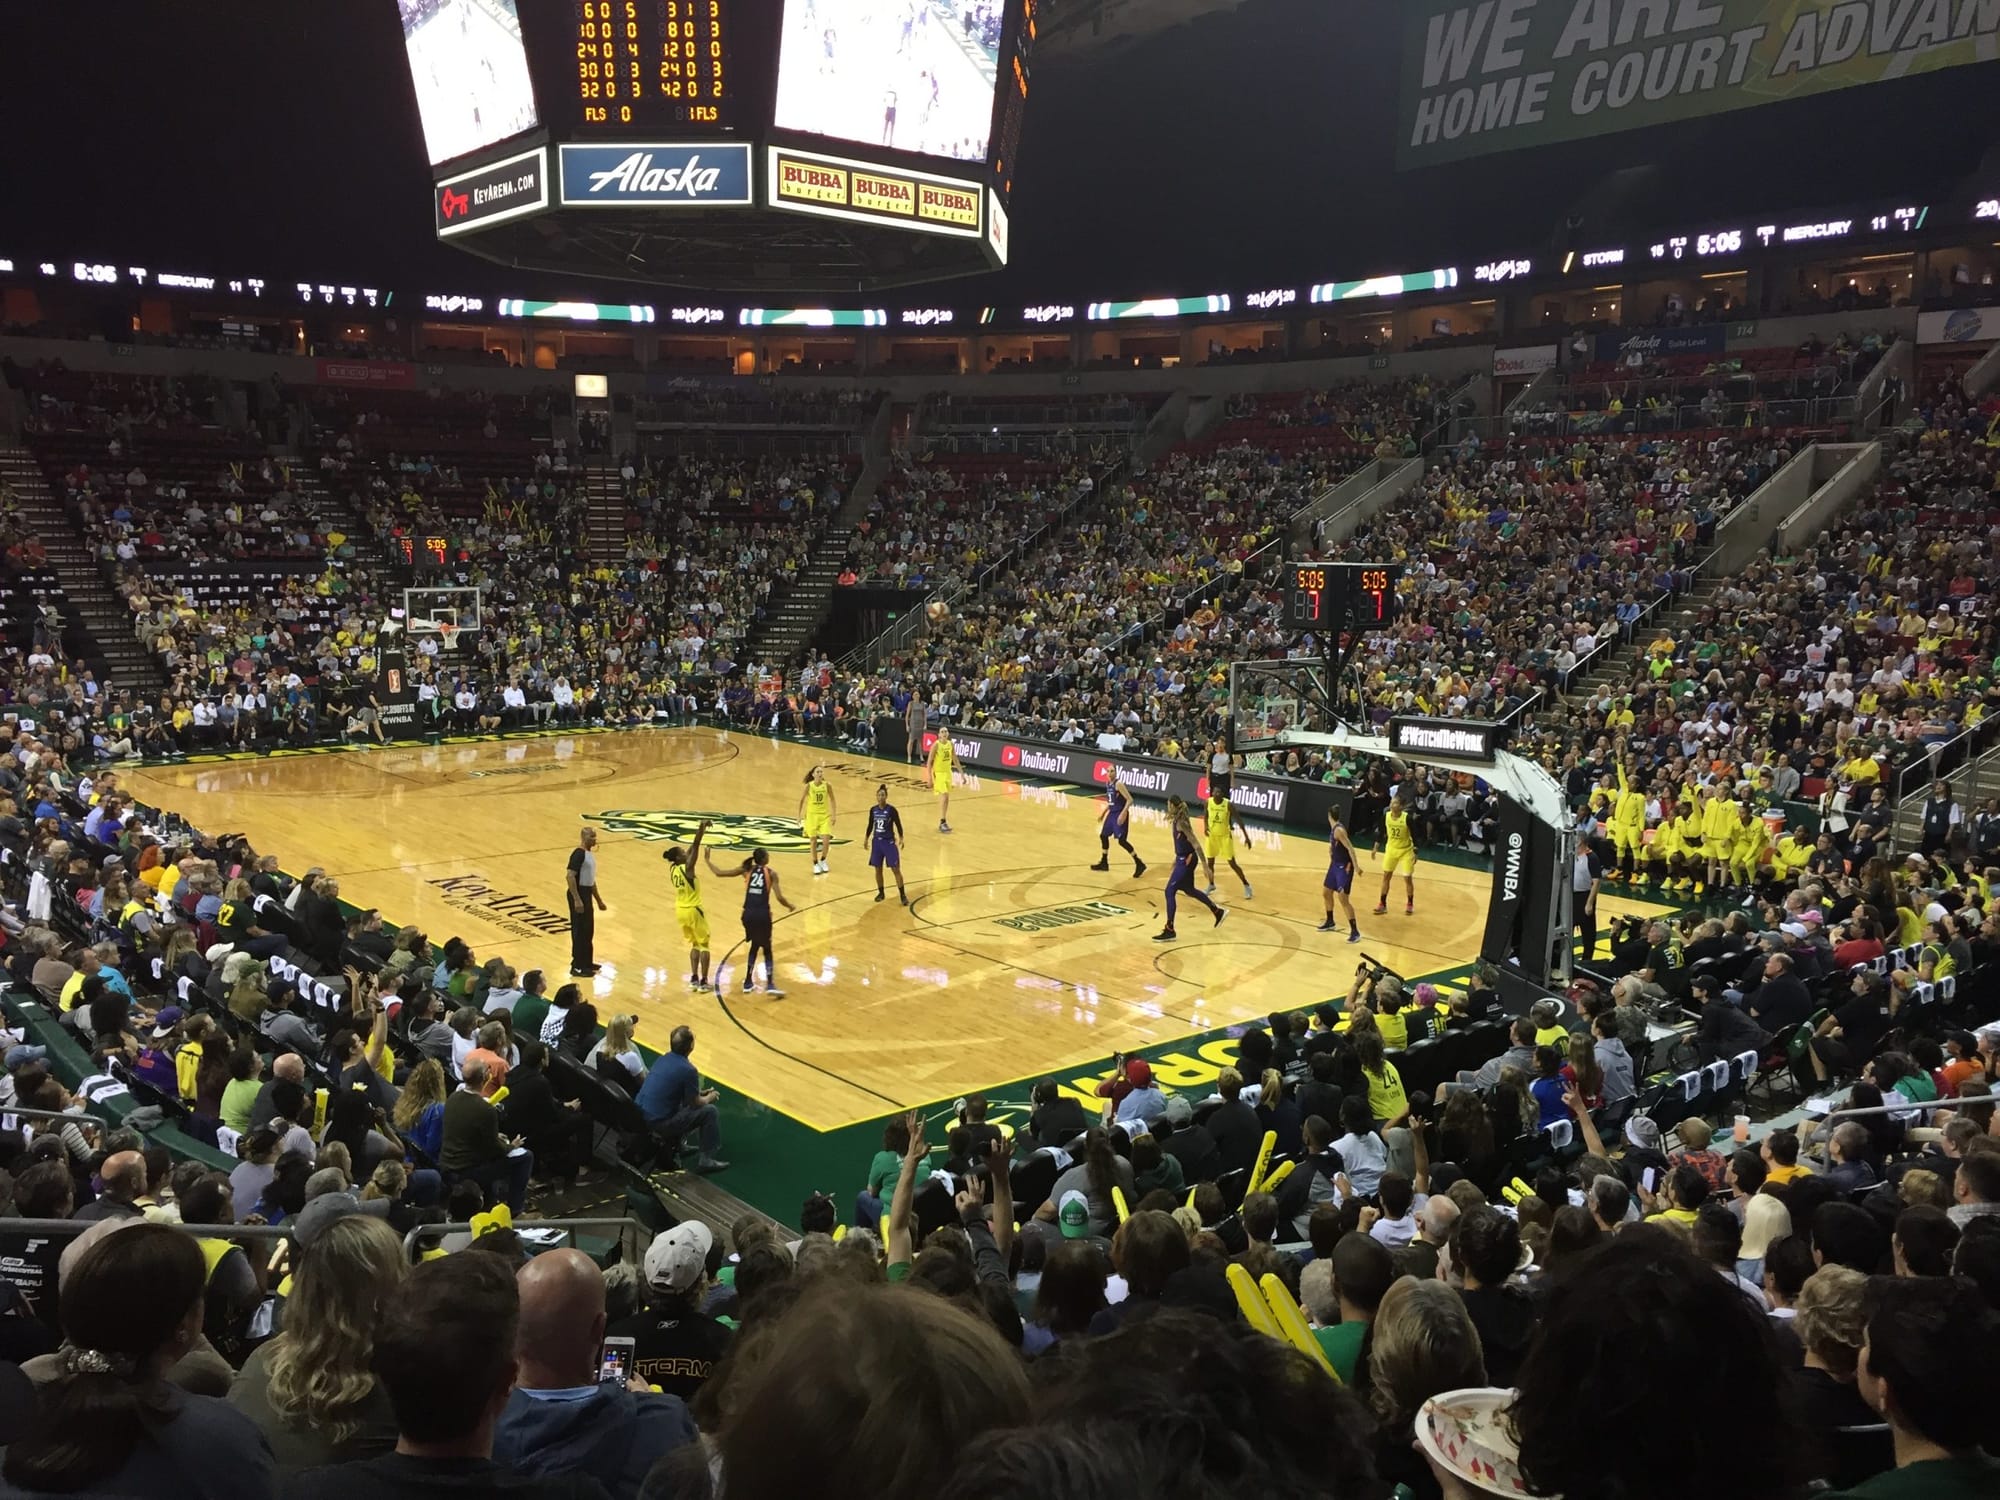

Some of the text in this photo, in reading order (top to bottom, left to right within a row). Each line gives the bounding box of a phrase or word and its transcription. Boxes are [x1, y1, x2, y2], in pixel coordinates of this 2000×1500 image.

[584, 2, 636, 18] 6 0 5
[668, 1, 718, 17] 3 1 3
[580, 22, 637, 38] 10 0 0
[668, 21, 720, 37] 8 0 3
[577, 42, 638, 58] 24 0 4
[664, 41, 720, 57] 12 0 0
[1421, 0, 1530, 87] WE
[579, 62, 639, 78] 30 0 3
[660, 61, 722, 77] 24 0 3
[581, 81, 641, 98] 32 0 3
[661, 81, 722, 97] 42 0 2
[1410, 71, 1554, 146] HOME
[1570, 25, 1766, 116] COURT
[585, 106, 631, 122] FLS 0
[696, 106, 717, 120] FLS
[589, 152, 720, 197] Alaska
[784, 166, 842, 189] BUBBA
[786, 183, 841, 200] burger
[856, 178, 910, 200] BUBBA
[858, 196, 910, 210] burger
[923, 190, 973, 211] BUBBA
[1976, 200, 1998, 217] 20
[924, 207, 973, 221] burger
[1583, 249, 1624, 266] STORM
[1697, 231, 1741, 255] 5:05
[1784, 220, 1851, 241] MERCURY
[1870, 216, 1887, 230] 11
[1674, 247, 1682, 259] 0
[73, 263, 117, 283] 5:05
[158, 274, 215, 289] MERCURY
[229, 281, 242, 292] 11
[1475, 260, 1531, 279] 20 20
[304, 291, 311, 301] 0
[325, 293, 333, 303] 0
[347, 295, 354, 304] 3
[369, 296, 376, 306] 3
[426, 296, 483, 310] 20 20
[1247, 290, 1295, 306] 20 20
[672, 308, 725, 322] 20 20
[902, 310, 954, 323] 20 20
[1024, 306, 1073, 319] 20 20
[1619, 333, 1661, 350] Alaska
[1374, 358, 1387, 368] 115
[426, 538, 447, 550] 5:05
[437, 549, 445, 565] 7
[1298, 569, 1325, 590] 5:05
[1362, 571, 1387, 590] 5:05
[1308, 590, 1320, 621] 7
[1371, 591, 1382, 620] 7
[877, 820, 884, 829] 12
[1391, 828, 1401, 837] 32
[1503, 833, 1523, 901] @WNBA
[750, 872, 765, 888] 24
[425, 874, 572, 934] KeyArena
